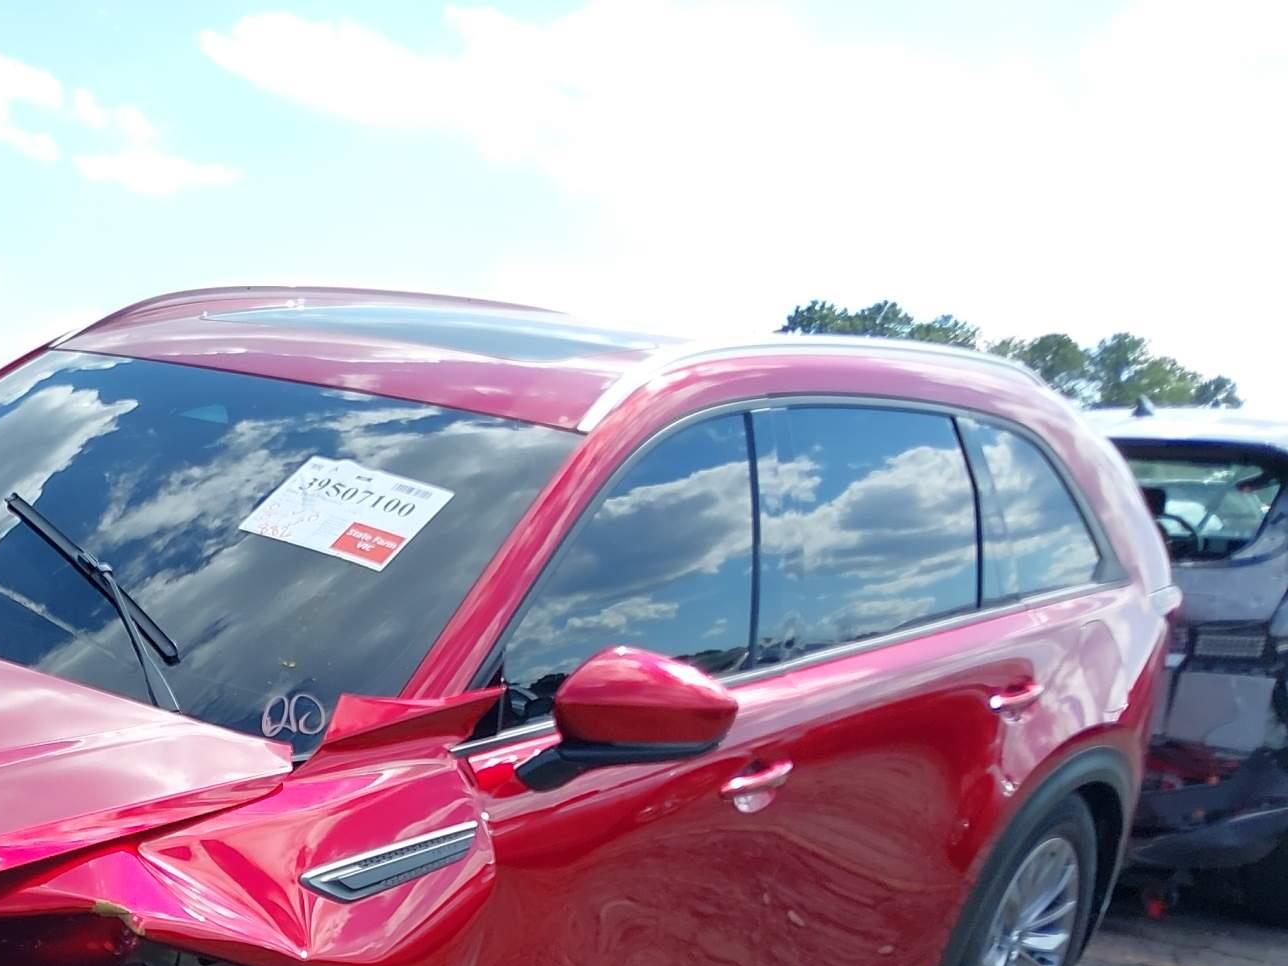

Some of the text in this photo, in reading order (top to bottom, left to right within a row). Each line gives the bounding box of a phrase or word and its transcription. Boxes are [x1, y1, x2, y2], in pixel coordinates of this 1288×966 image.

[299, 477, 417, 518] 39507100
[346, 528, 397, 550] State Farm
